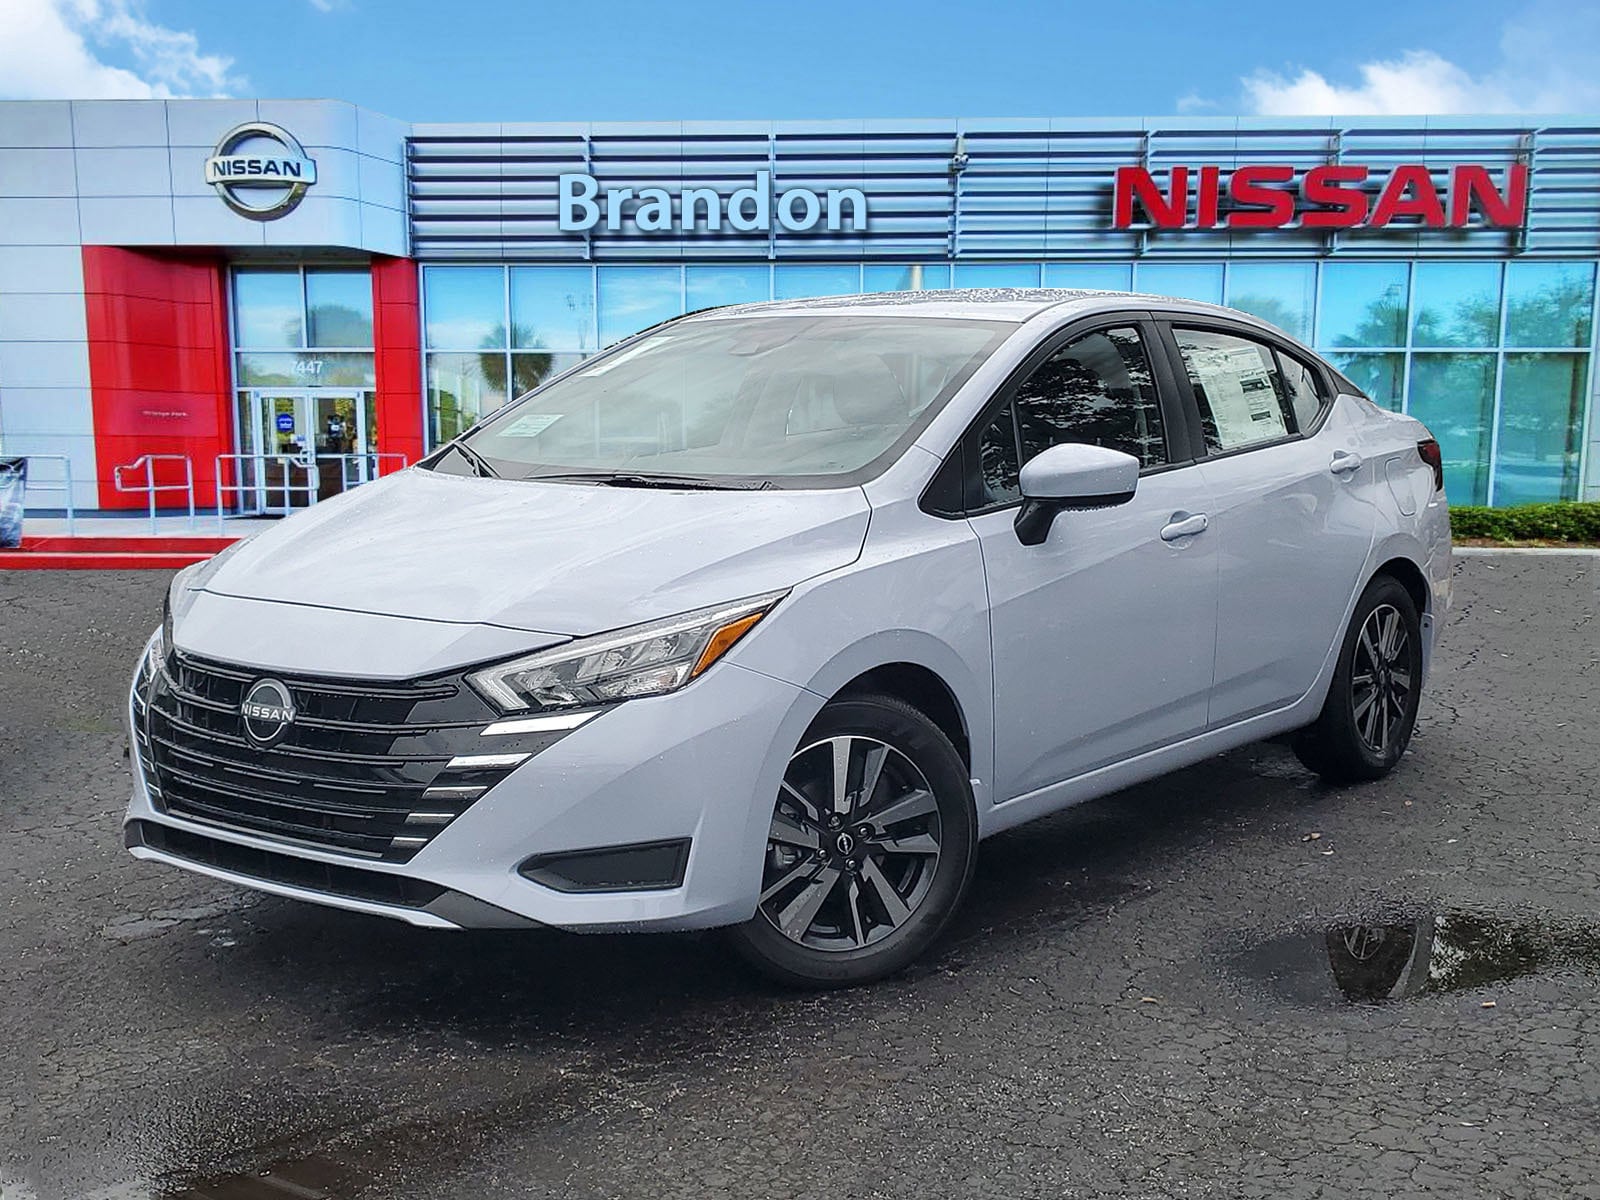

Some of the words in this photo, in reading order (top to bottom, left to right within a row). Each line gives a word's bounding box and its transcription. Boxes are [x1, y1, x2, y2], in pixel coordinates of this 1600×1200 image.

[213, 160, 301, 177] NISSAN
[558, 171, 867, 232] Brandon
[1113, 165, 1528, 229] NISSAN
[241, 702, 294, 721] NISSAN
